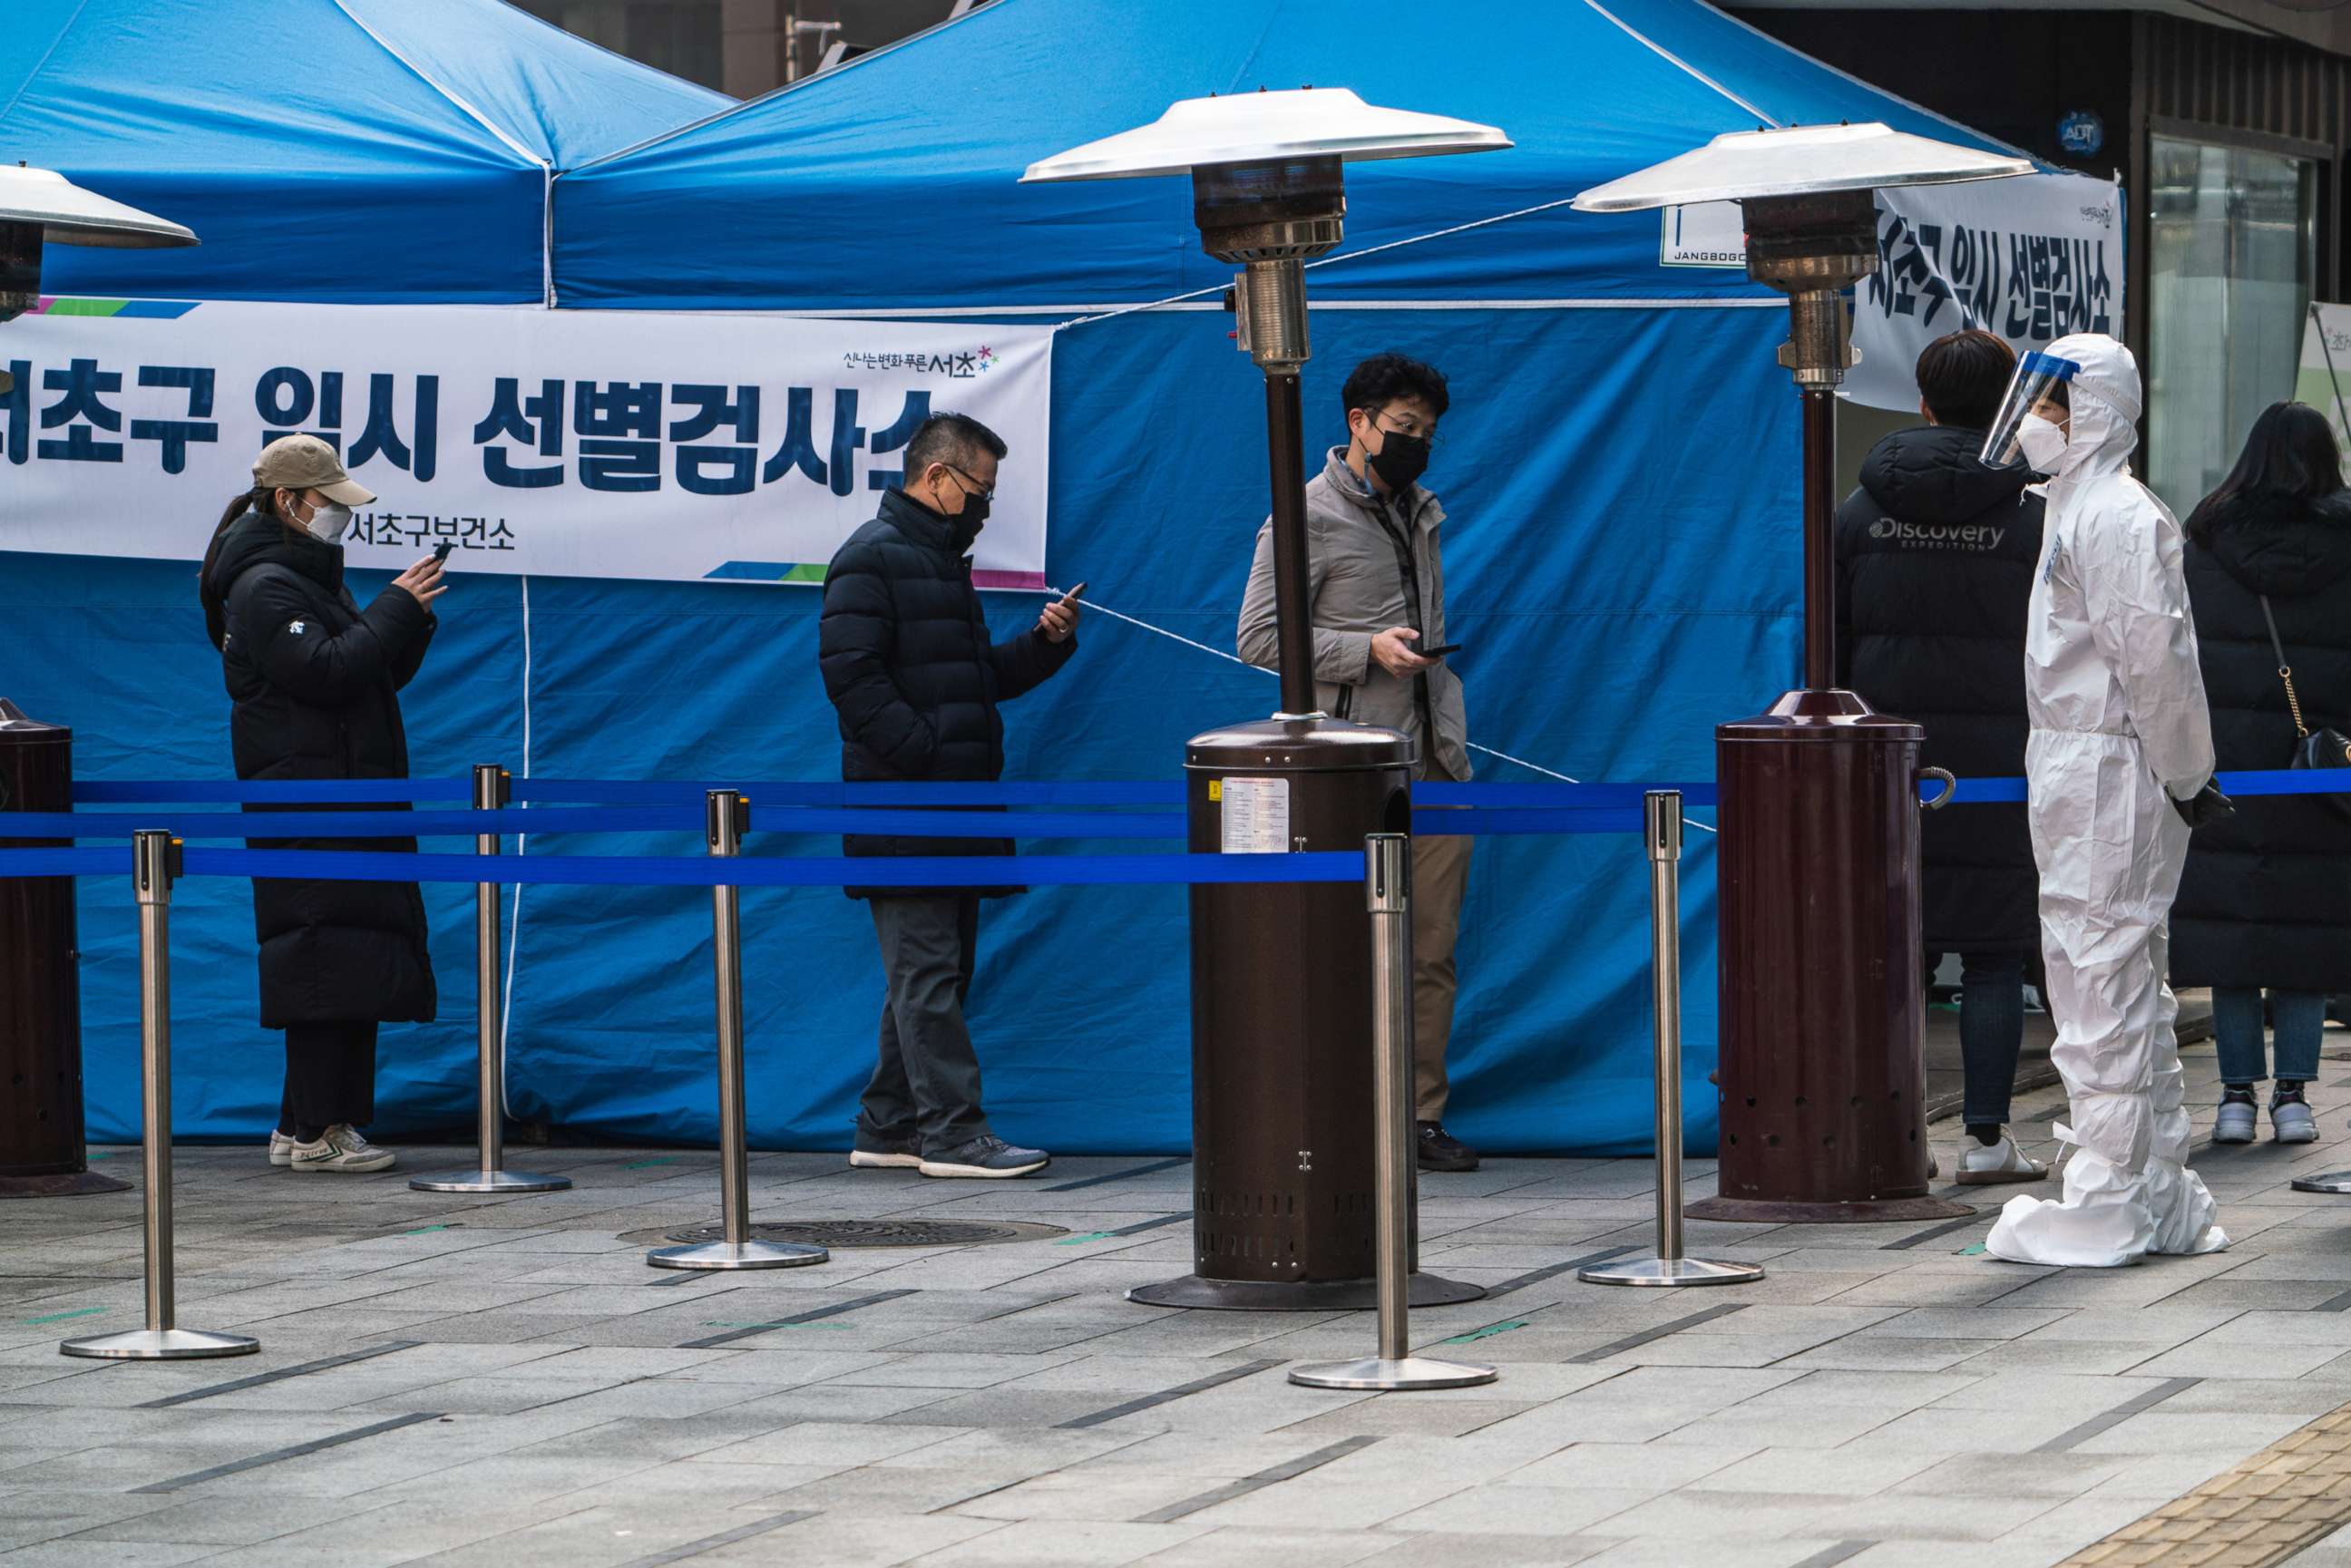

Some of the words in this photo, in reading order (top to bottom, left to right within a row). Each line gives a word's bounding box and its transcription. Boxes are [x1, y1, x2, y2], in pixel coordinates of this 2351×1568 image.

[2062, 123, 2094, 142] ADT
[1868, 208, 1953, 327] 서초구
[1951, 224, 2000, 333] 임시
[2005, 232, 2110, 340] 선별검사소
[929, 351, 976, 377] 서초
[255, 366, 439, 482] 임시
[347, 512, 515, 550] 서초구보건소
[1901, 540, 1985, 551] EXPEDITION
